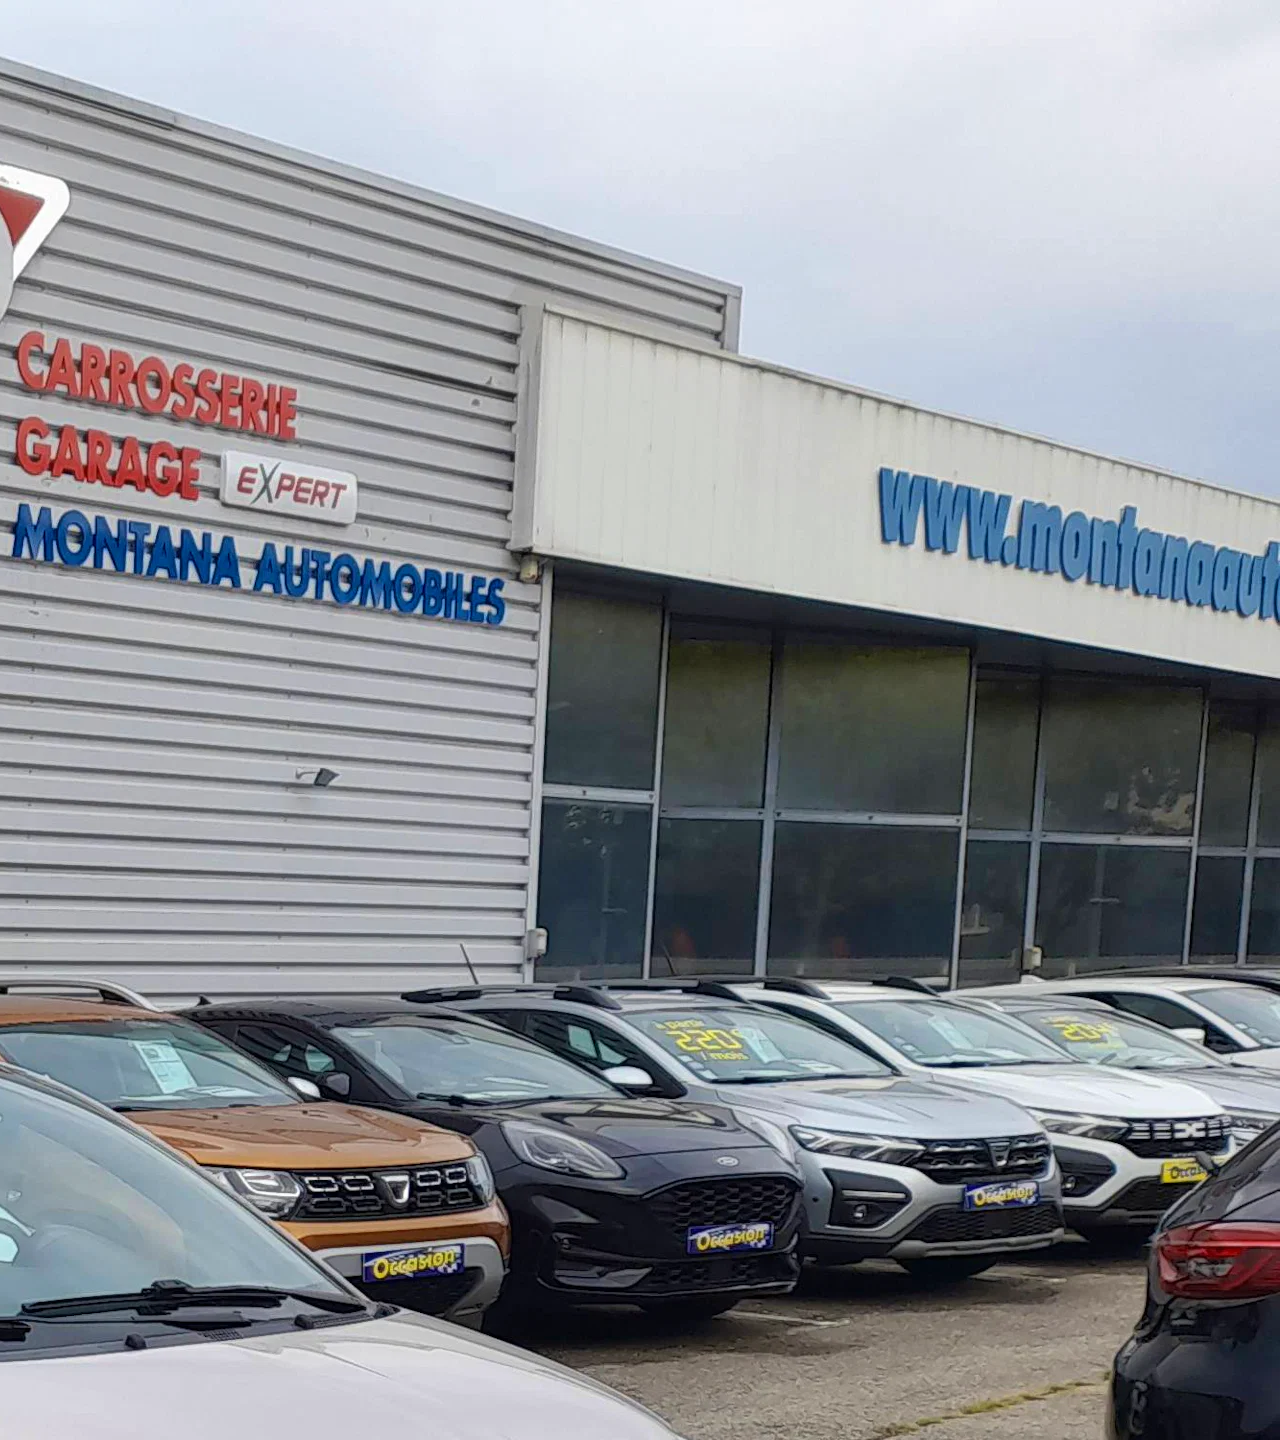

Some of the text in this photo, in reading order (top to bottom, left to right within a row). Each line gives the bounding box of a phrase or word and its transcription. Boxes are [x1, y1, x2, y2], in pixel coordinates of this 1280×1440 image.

[16, 330, 298, 440] CARROSSERIE
[16, 416, 348, 510] GARAGE EXPERT
[12, 503, 508, 626] MONTANA AUTOMOBILES
[878, 466, 1280, 628] www.montanaaut
[373, 1249, 455, 1279] Occasion
[696, 1230, 766, 1252] Occasion
